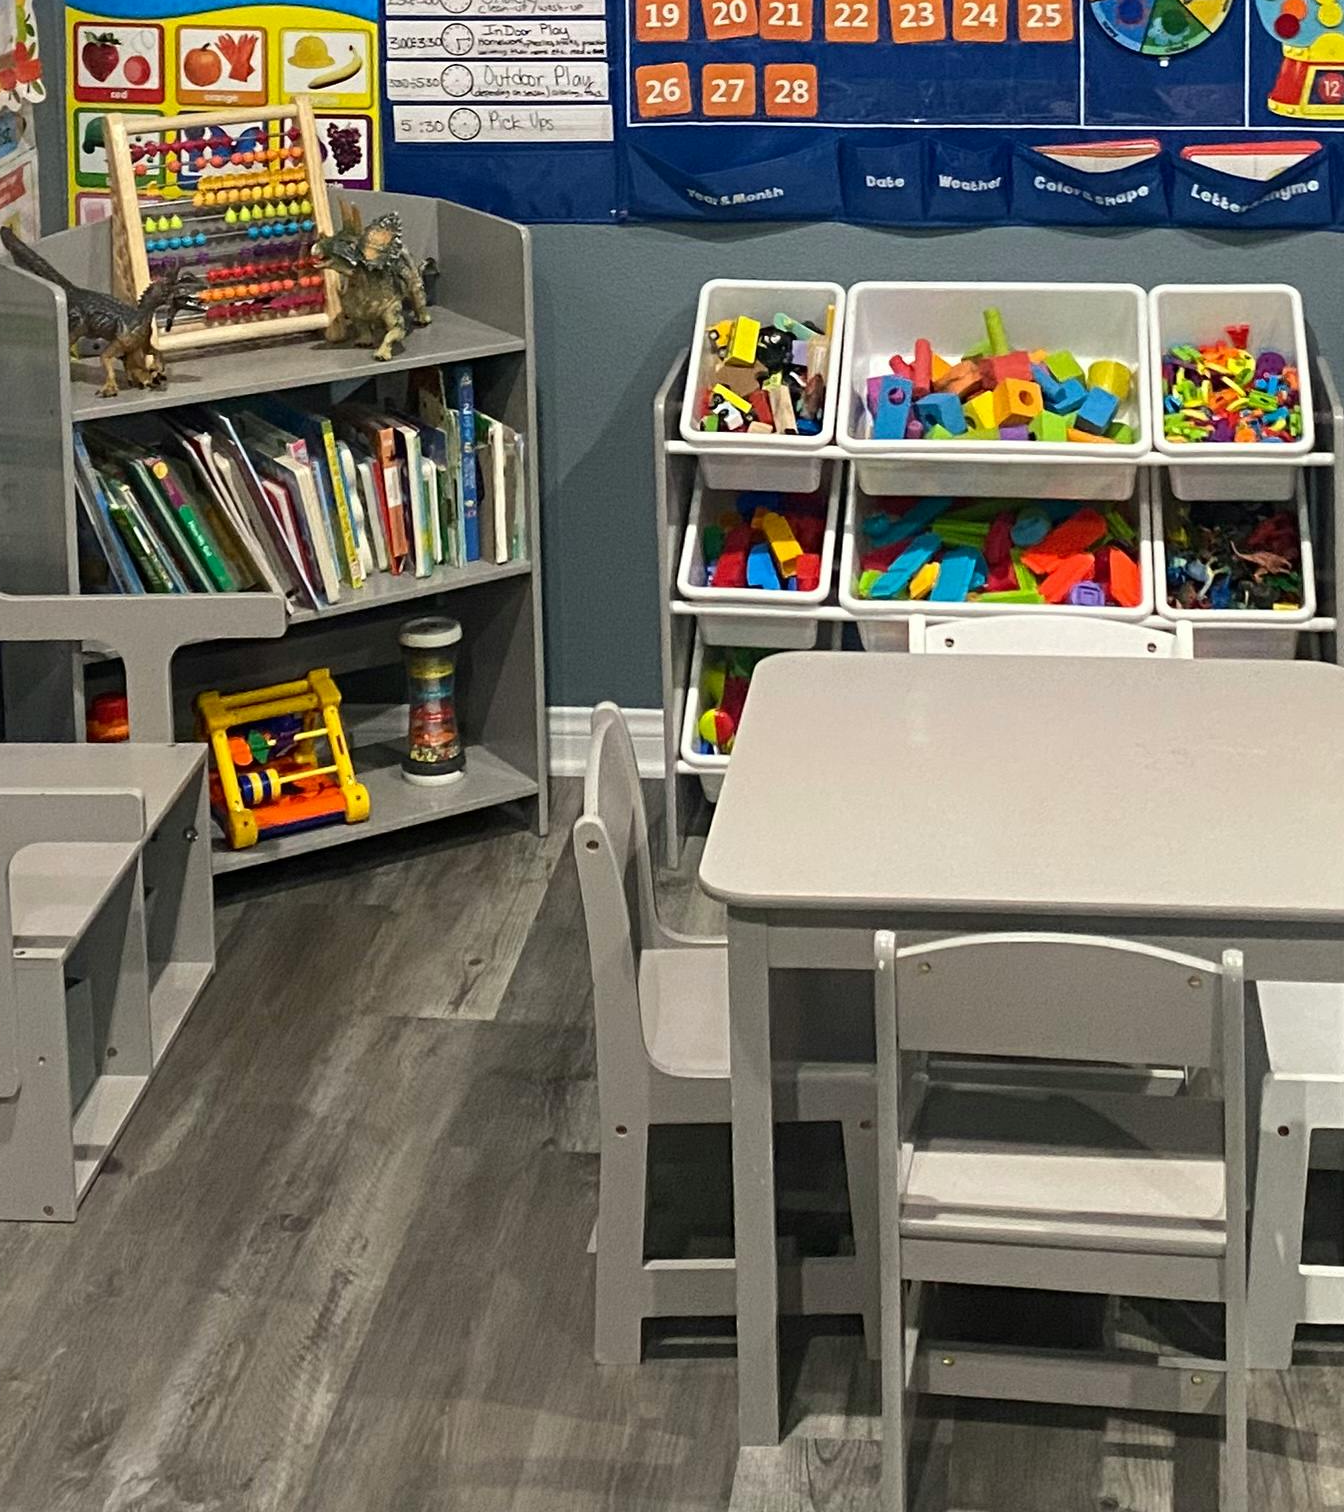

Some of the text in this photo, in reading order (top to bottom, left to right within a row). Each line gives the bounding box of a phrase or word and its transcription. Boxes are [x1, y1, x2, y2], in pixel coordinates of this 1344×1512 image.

[541, 24, 569, 37] Play
[484, 65, 594, 88] Outdoor Play
[111, 90, 128, 99] red
[1323, 80, 1341, 97] 12
[489, 111, 554, 131] Pick Ups
[866, 175, 905, 189] Date
[938, 175, 1001, 192] Weather
